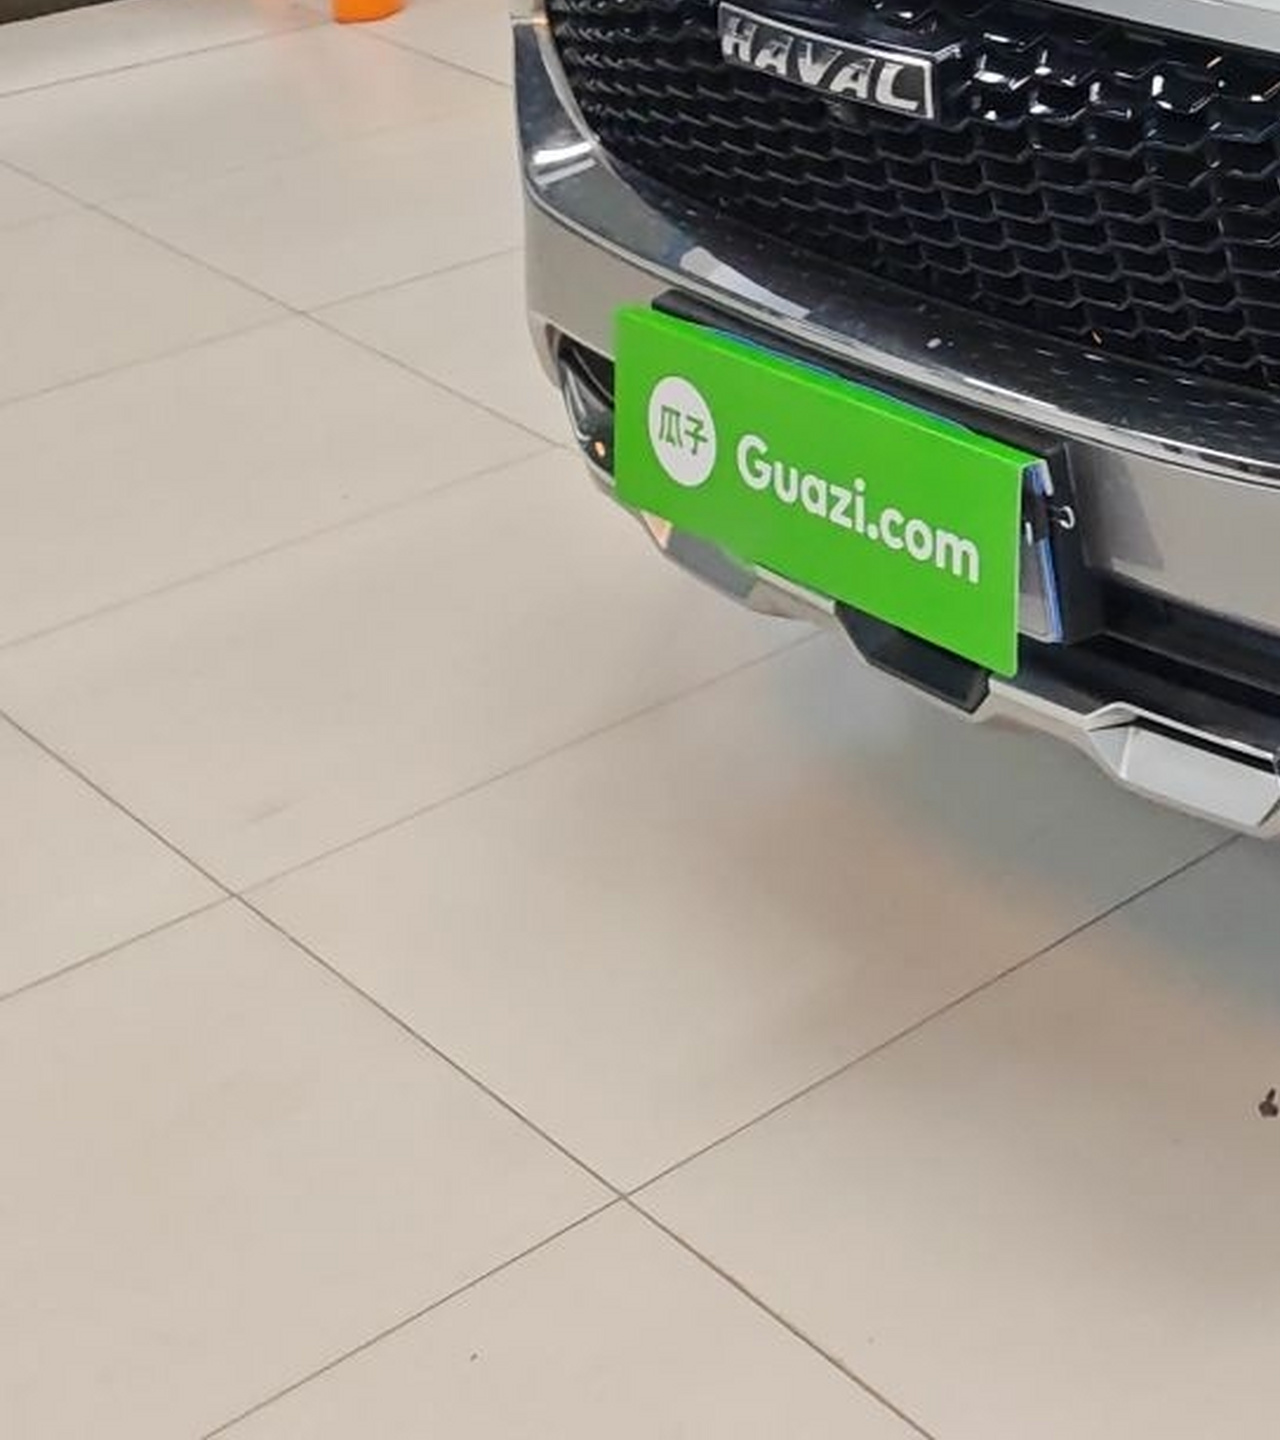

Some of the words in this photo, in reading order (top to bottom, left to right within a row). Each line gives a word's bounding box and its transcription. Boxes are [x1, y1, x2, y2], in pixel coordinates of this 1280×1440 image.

[721, 16, 920, 111] HAVAL
[658, 406, 708, 457] 瓜子
[736, 434, 980, 584] Guazi.com
